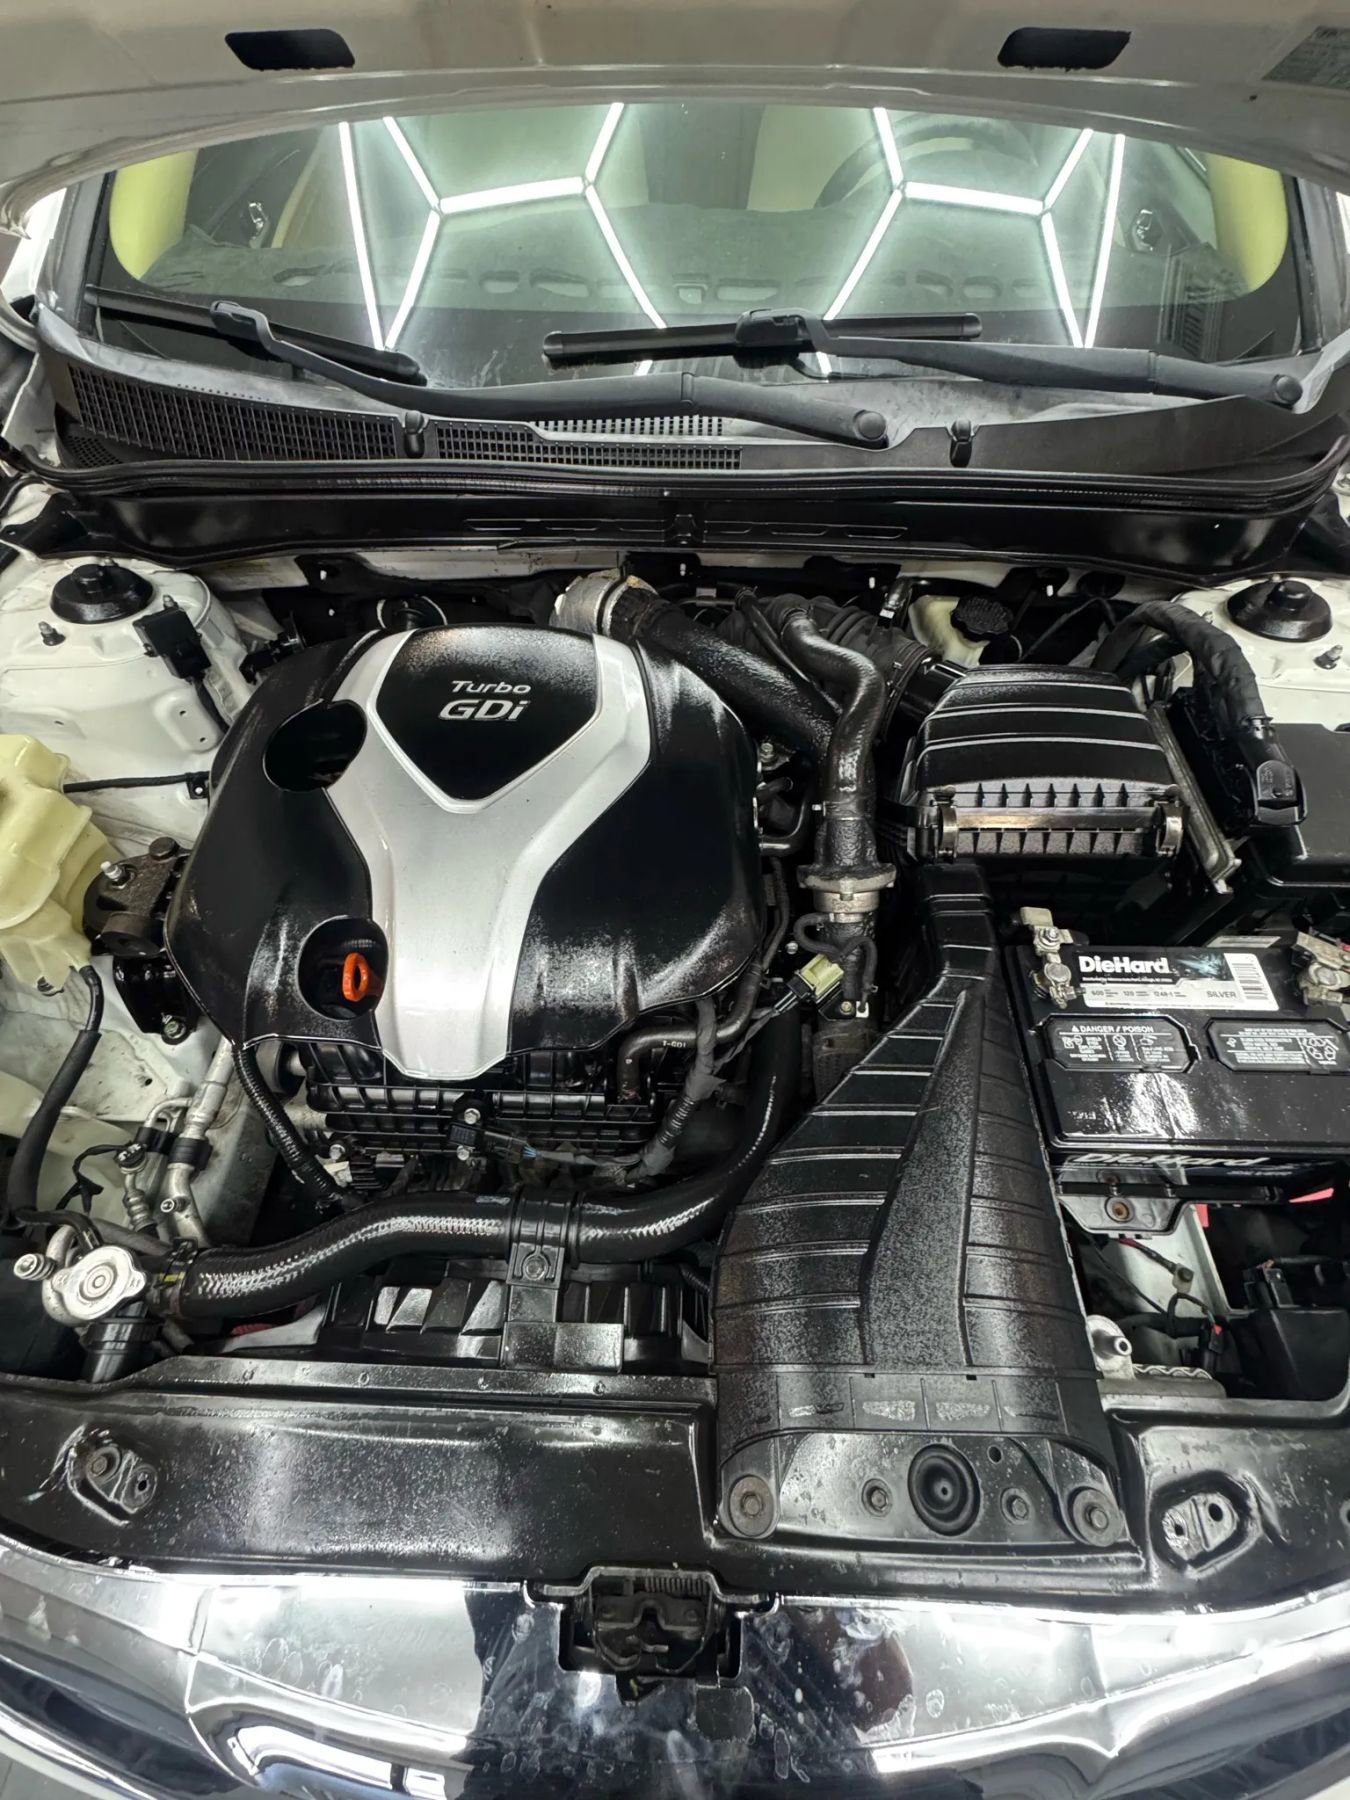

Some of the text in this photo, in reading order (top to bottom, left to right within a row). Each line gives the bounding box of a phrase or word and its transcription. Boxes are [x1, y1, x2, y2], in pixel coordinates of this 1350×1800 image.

[452, 680, 531, 693] Turbo
[439, 699, 530, 720] GDi
[1078, 955, 1170, 973] DieHard
[1206, 990, 1238, 998] SILVER
[1080, 1025, 1115, 1033] DANGER
[1122, 1025, 1155, 1034] POISON
[1073, 1153, 1270, 1166] DieHard
